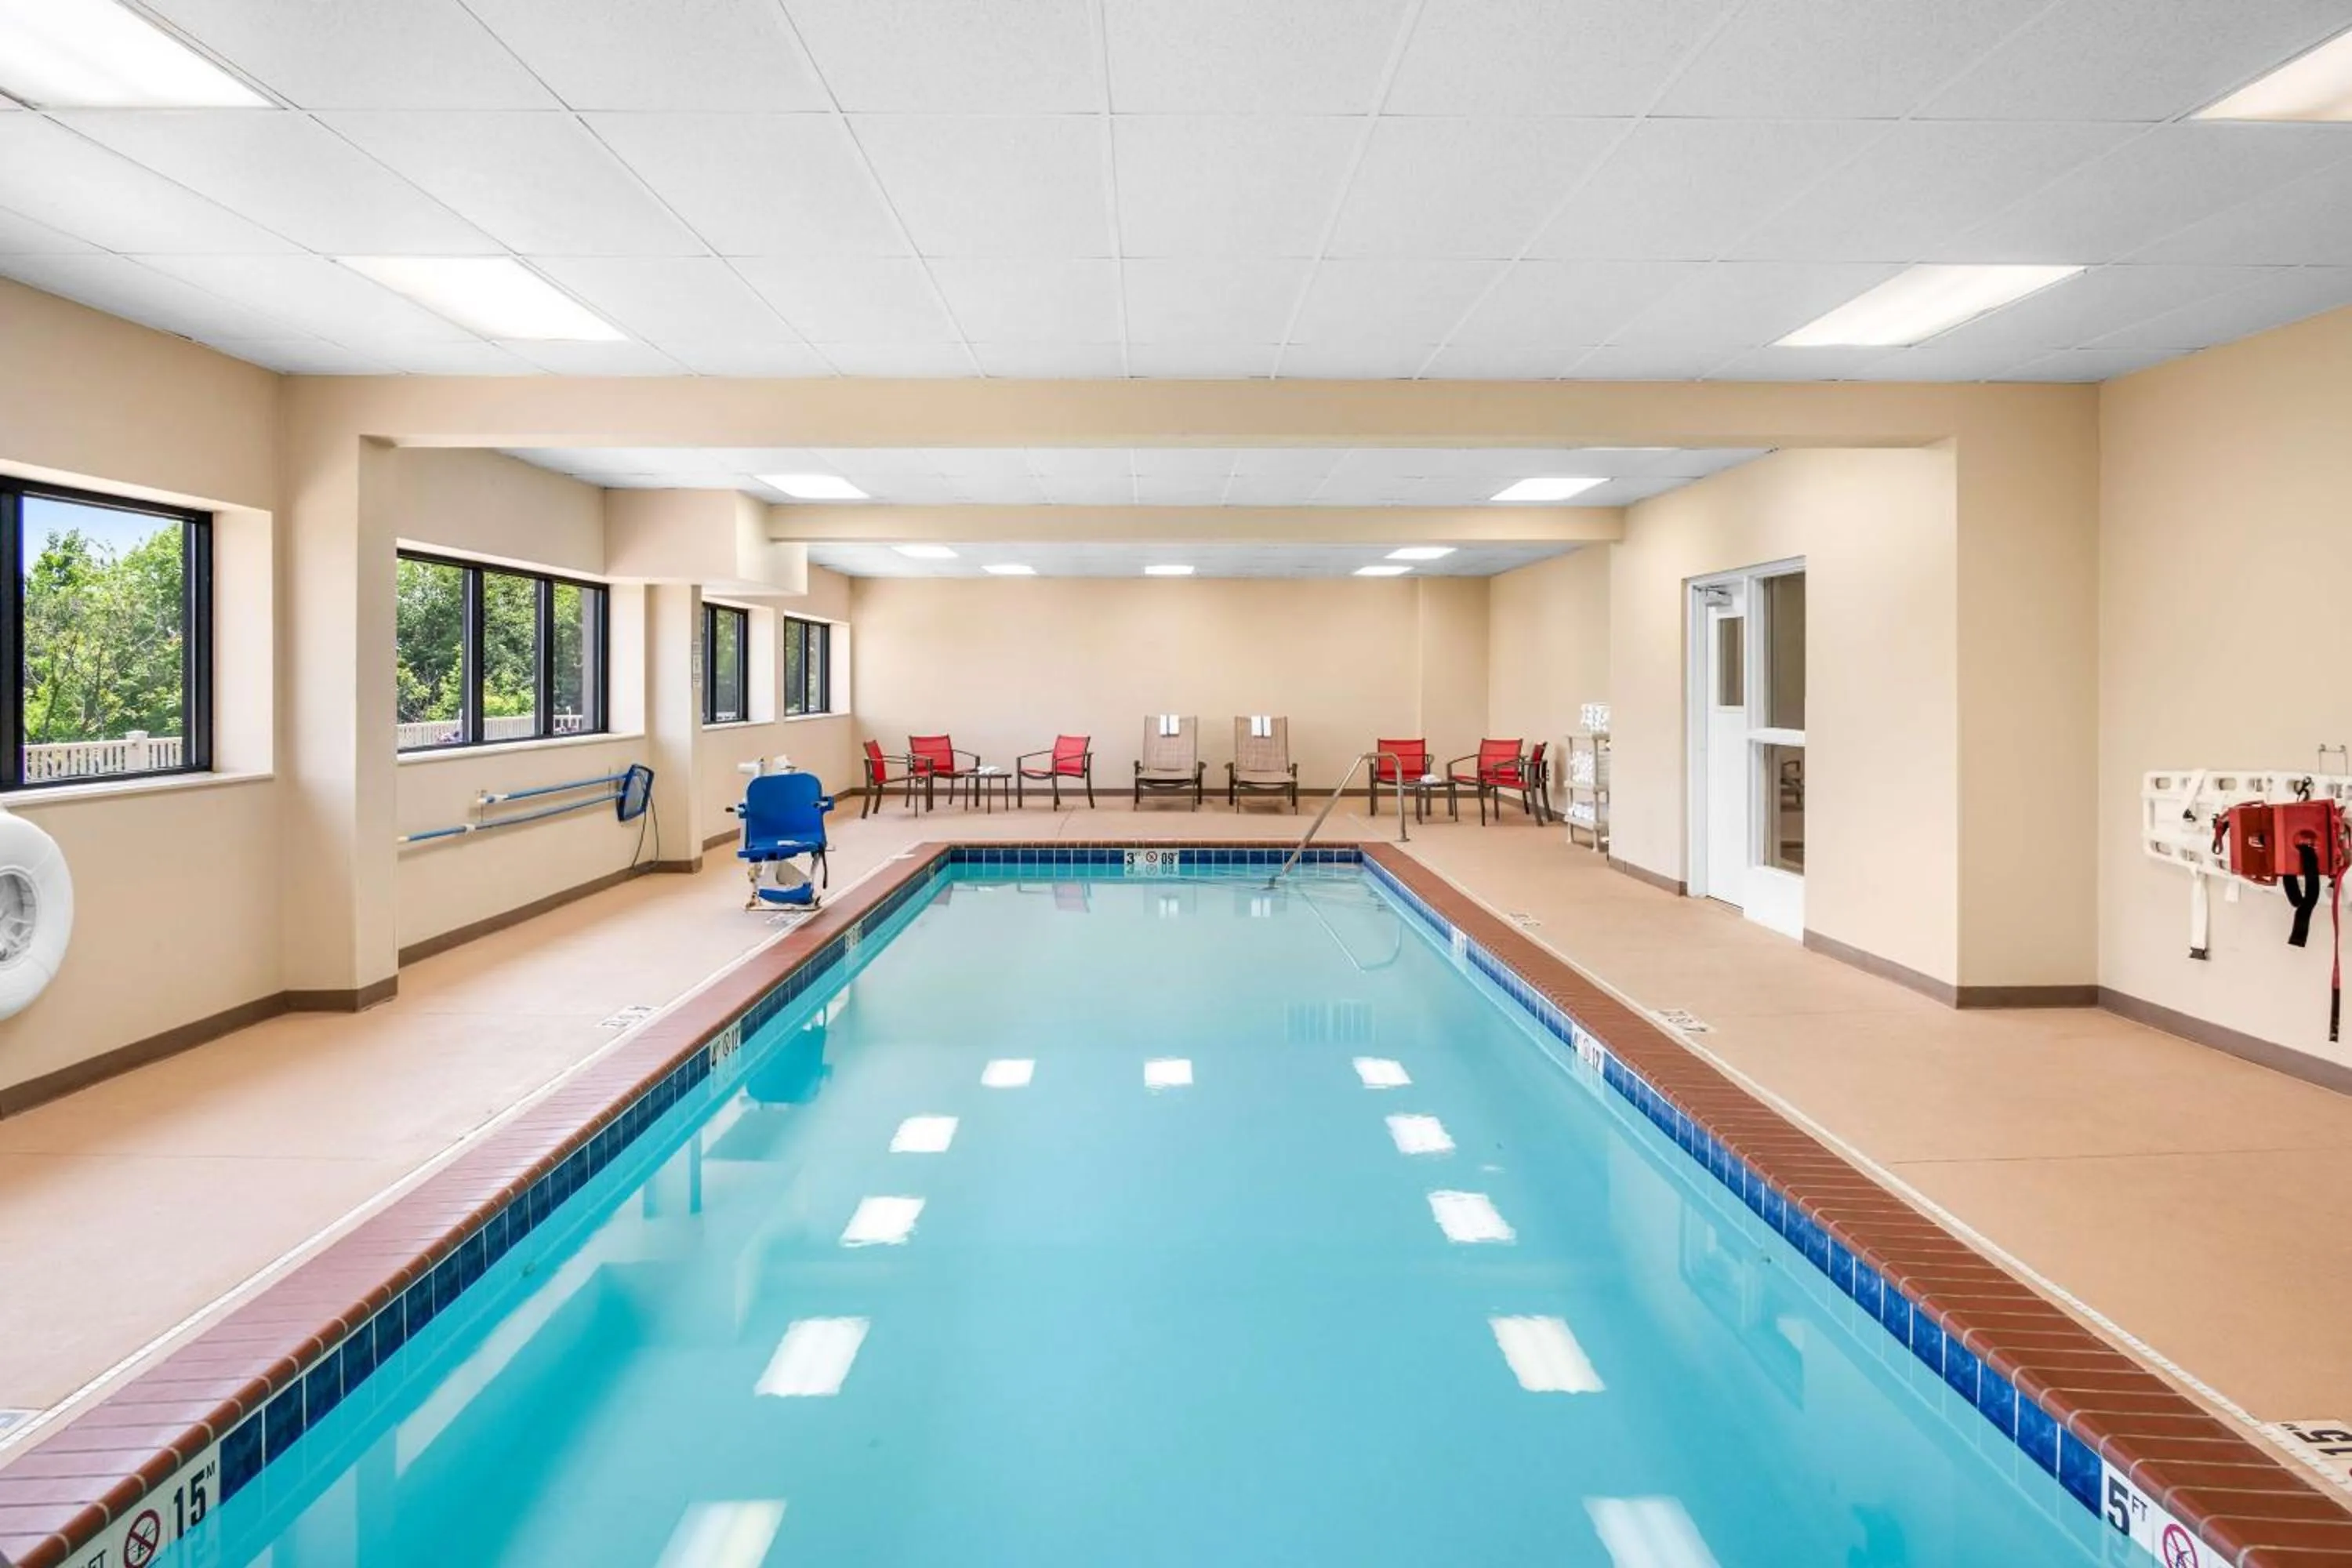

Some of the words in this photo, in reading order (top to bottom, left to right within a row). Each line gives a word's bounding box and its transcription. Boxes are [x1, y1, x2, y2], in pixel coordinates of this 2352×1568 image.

[1127, 851, 1134, 865] 3
[2107, 1475, 2130, 1537] 5
[2132, 1494, 2148, 1522] FT
